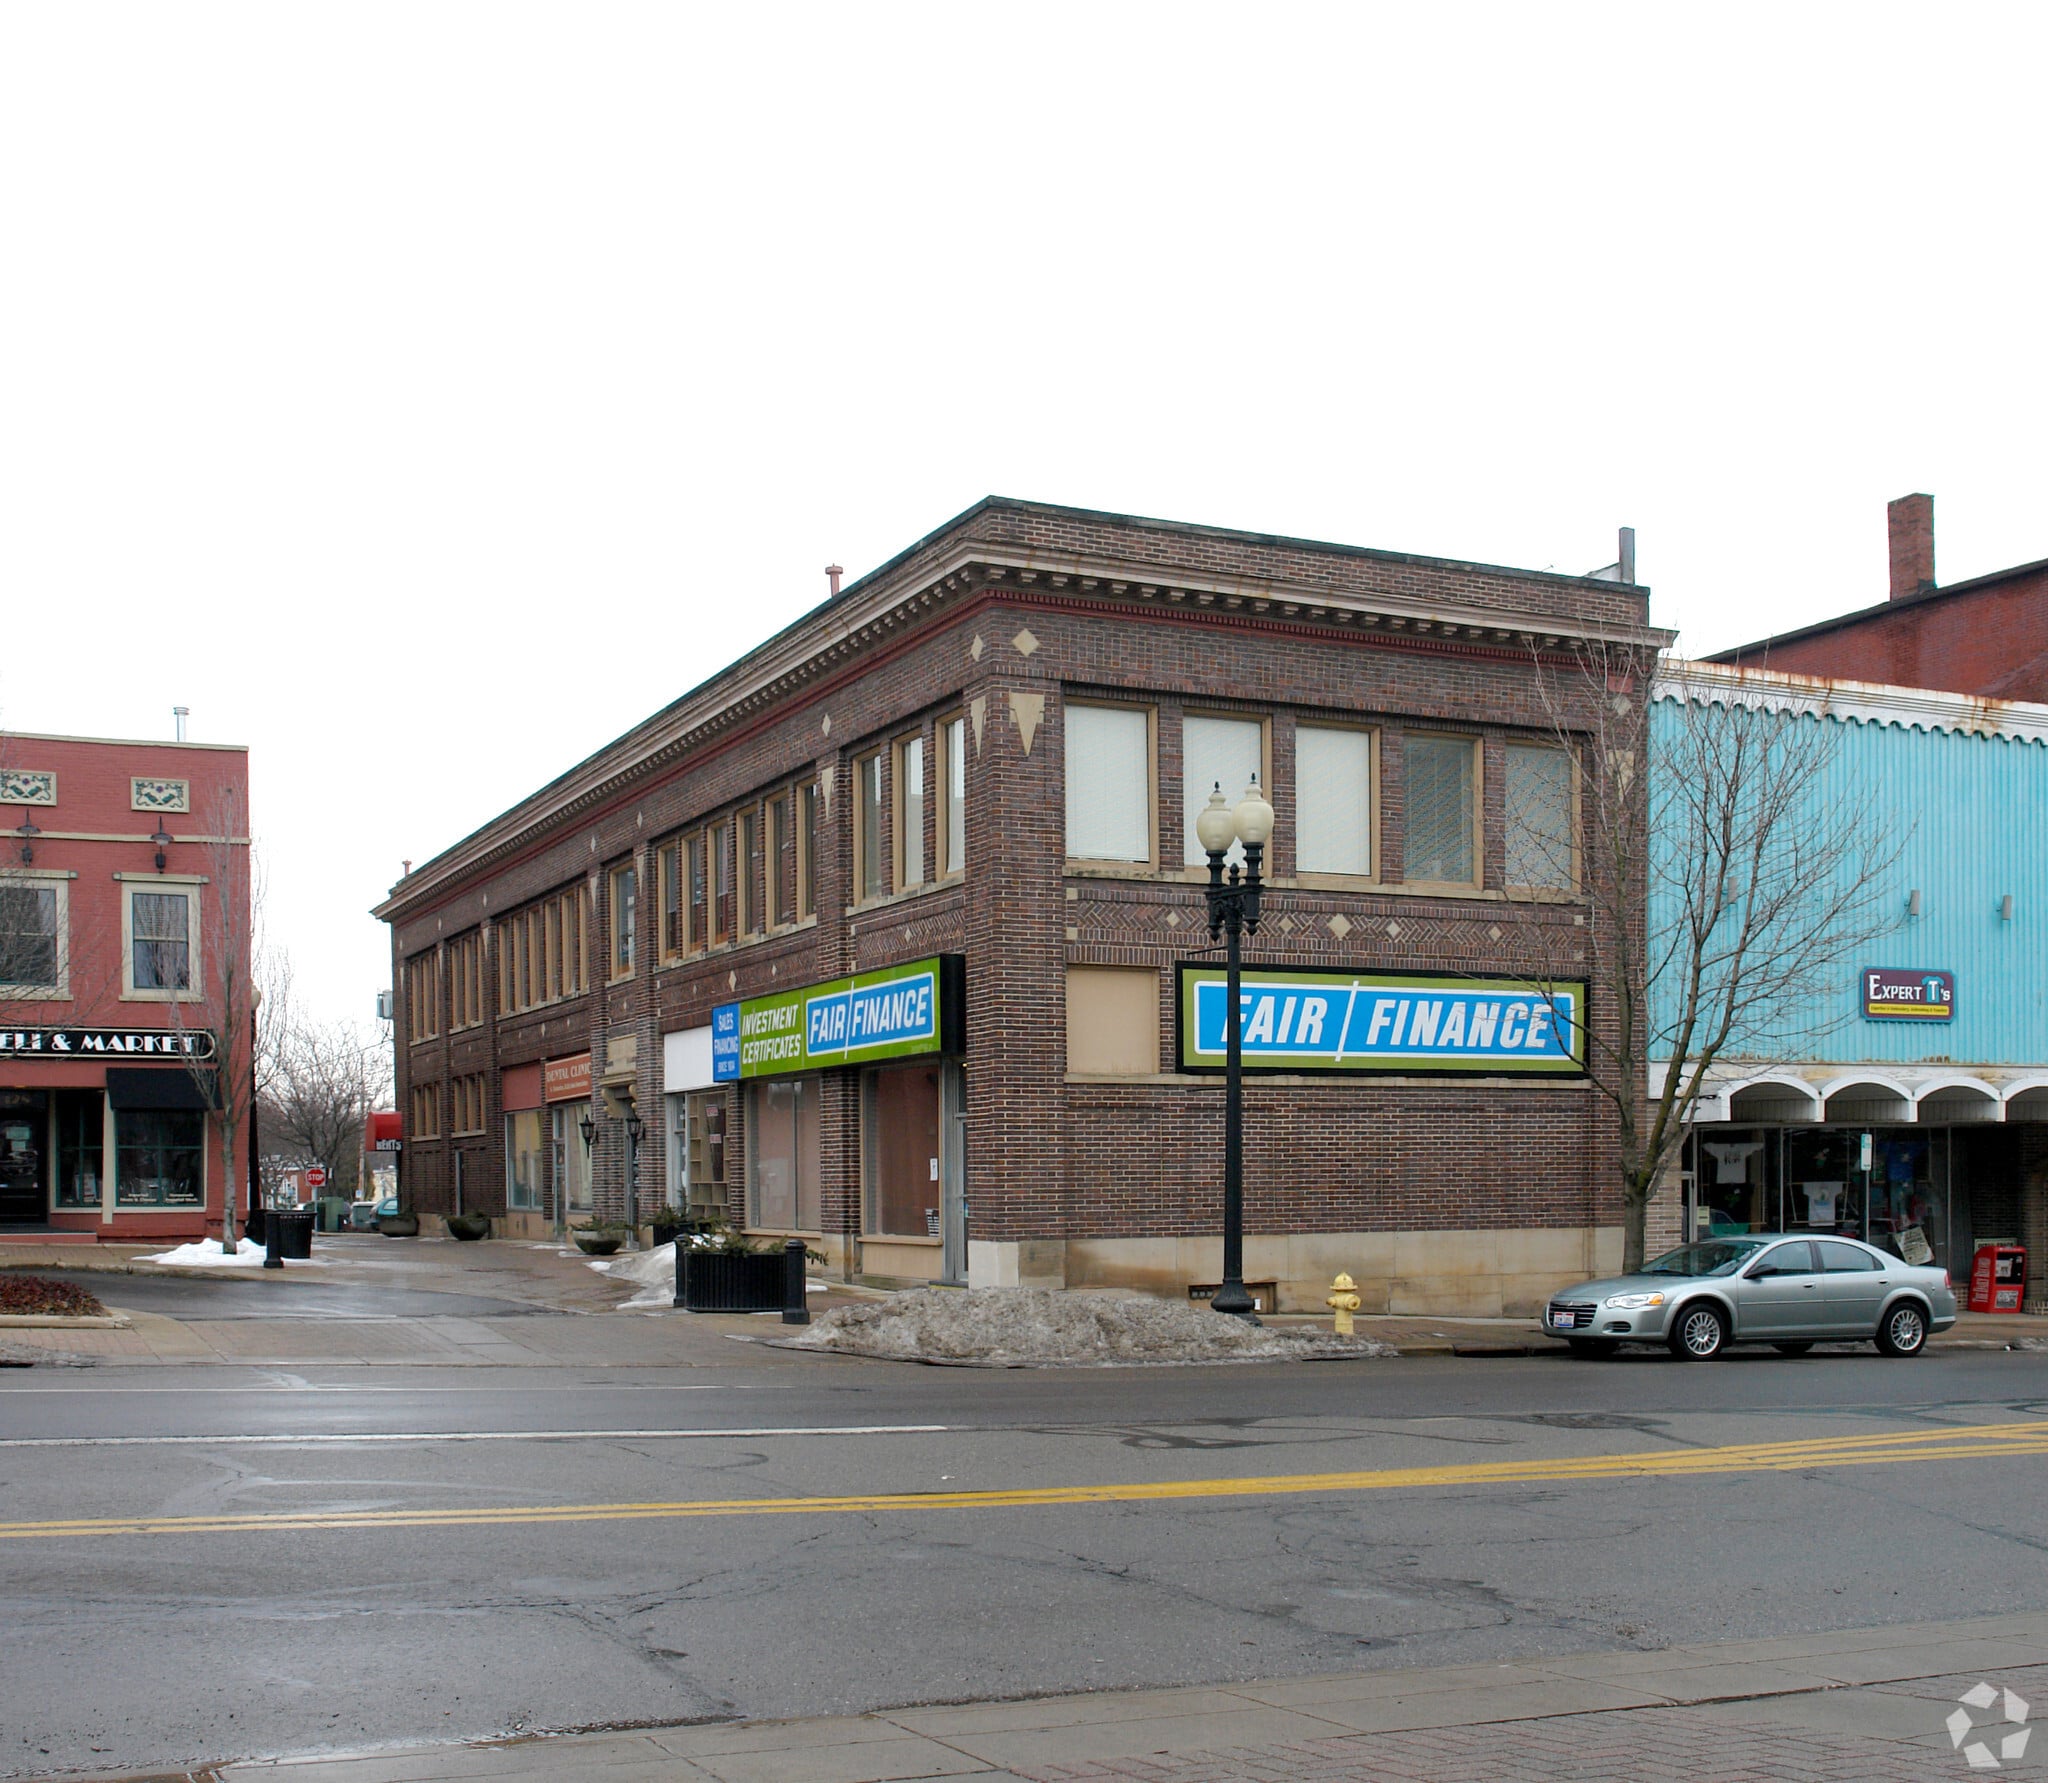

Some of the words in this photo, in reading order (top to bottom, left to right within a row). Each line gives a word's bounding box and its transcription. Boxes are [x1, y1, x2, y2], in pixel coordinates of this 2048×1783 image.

[718, 1012, 734, 1032] SALES
[742, 1004, 799, 1037] INVESTMENT
[810, 1004, 846, 1045] FAIR
[852, 986, 930, 1037] FINANCE
[1366, 999, 1552, 1049] FINANCE
[51, 1033, 71, 1051] &
[81, 1035, 195, 1053] MARKET
[742, 1034, 801, 1065] CERTIFICATES
[546, 1068, 569, 1082] DENTAL
[570, 1062, 592, 1078] CLINIC
[307, 1173, 324, 1181] STOP
